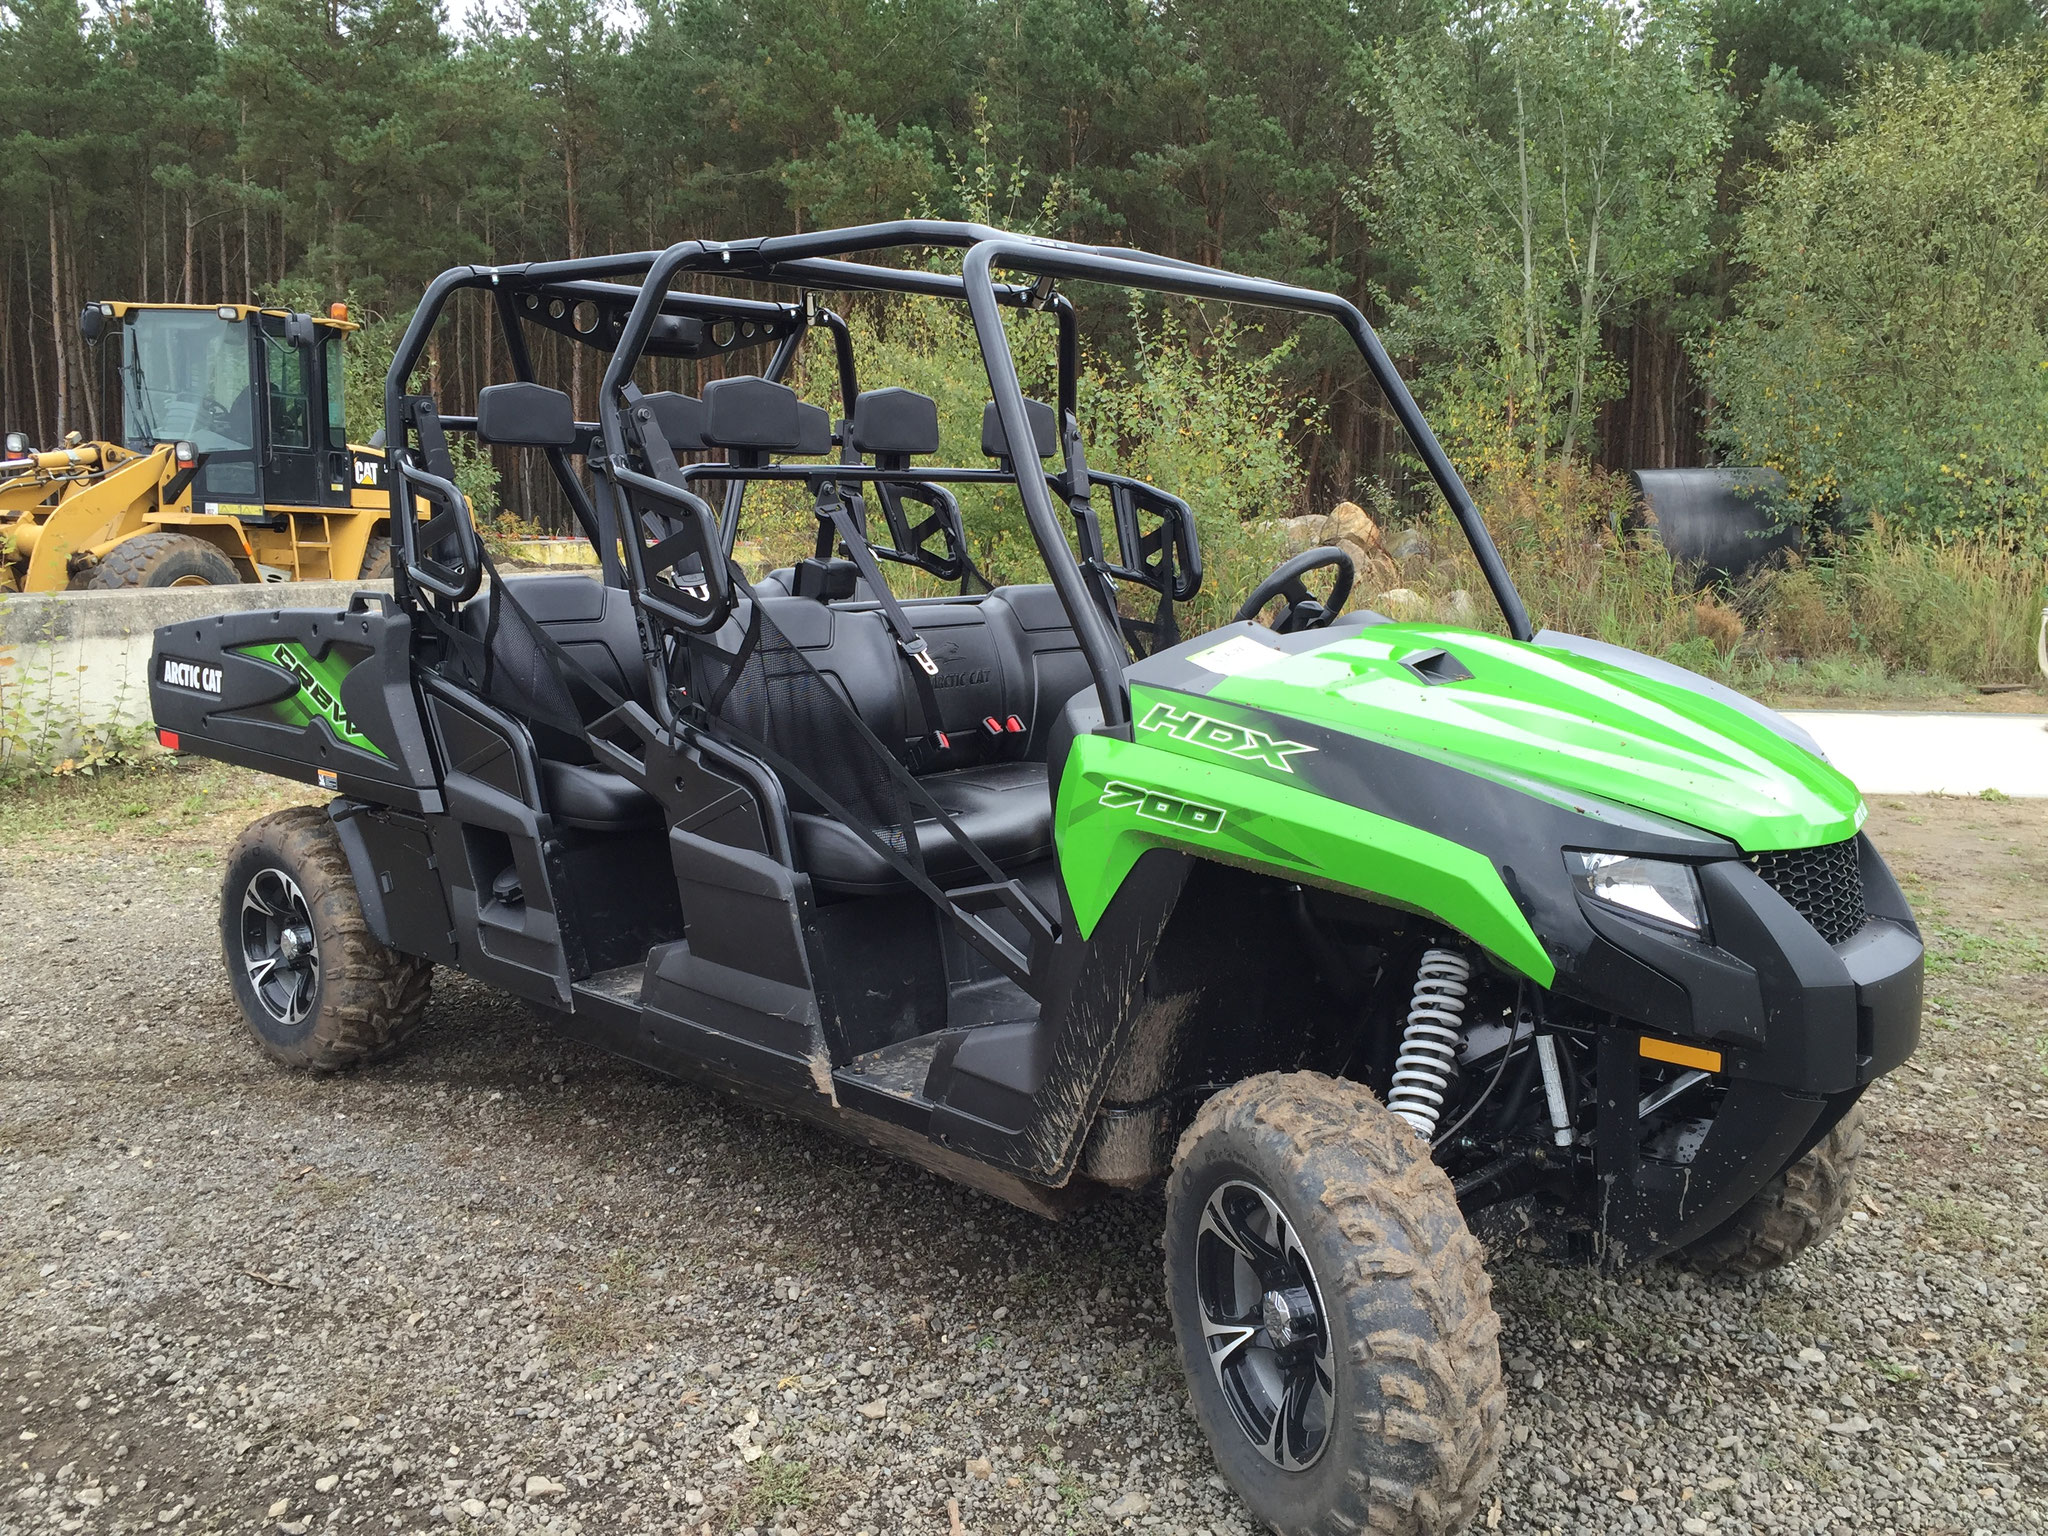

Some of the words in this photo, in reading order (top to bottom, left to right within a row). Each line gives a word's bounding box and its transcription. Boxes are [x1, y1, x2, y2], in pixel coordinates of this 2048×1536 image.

[354, 461, 378, 485] CAT
[164, 660, 200, 690] ARCTIC
[202, 667, 223, 694] CAT
[969, 669, 991, 686] CAT
[1138, 702, 1320, 774] HDX
[1099, 780, 1227, 833] 700
